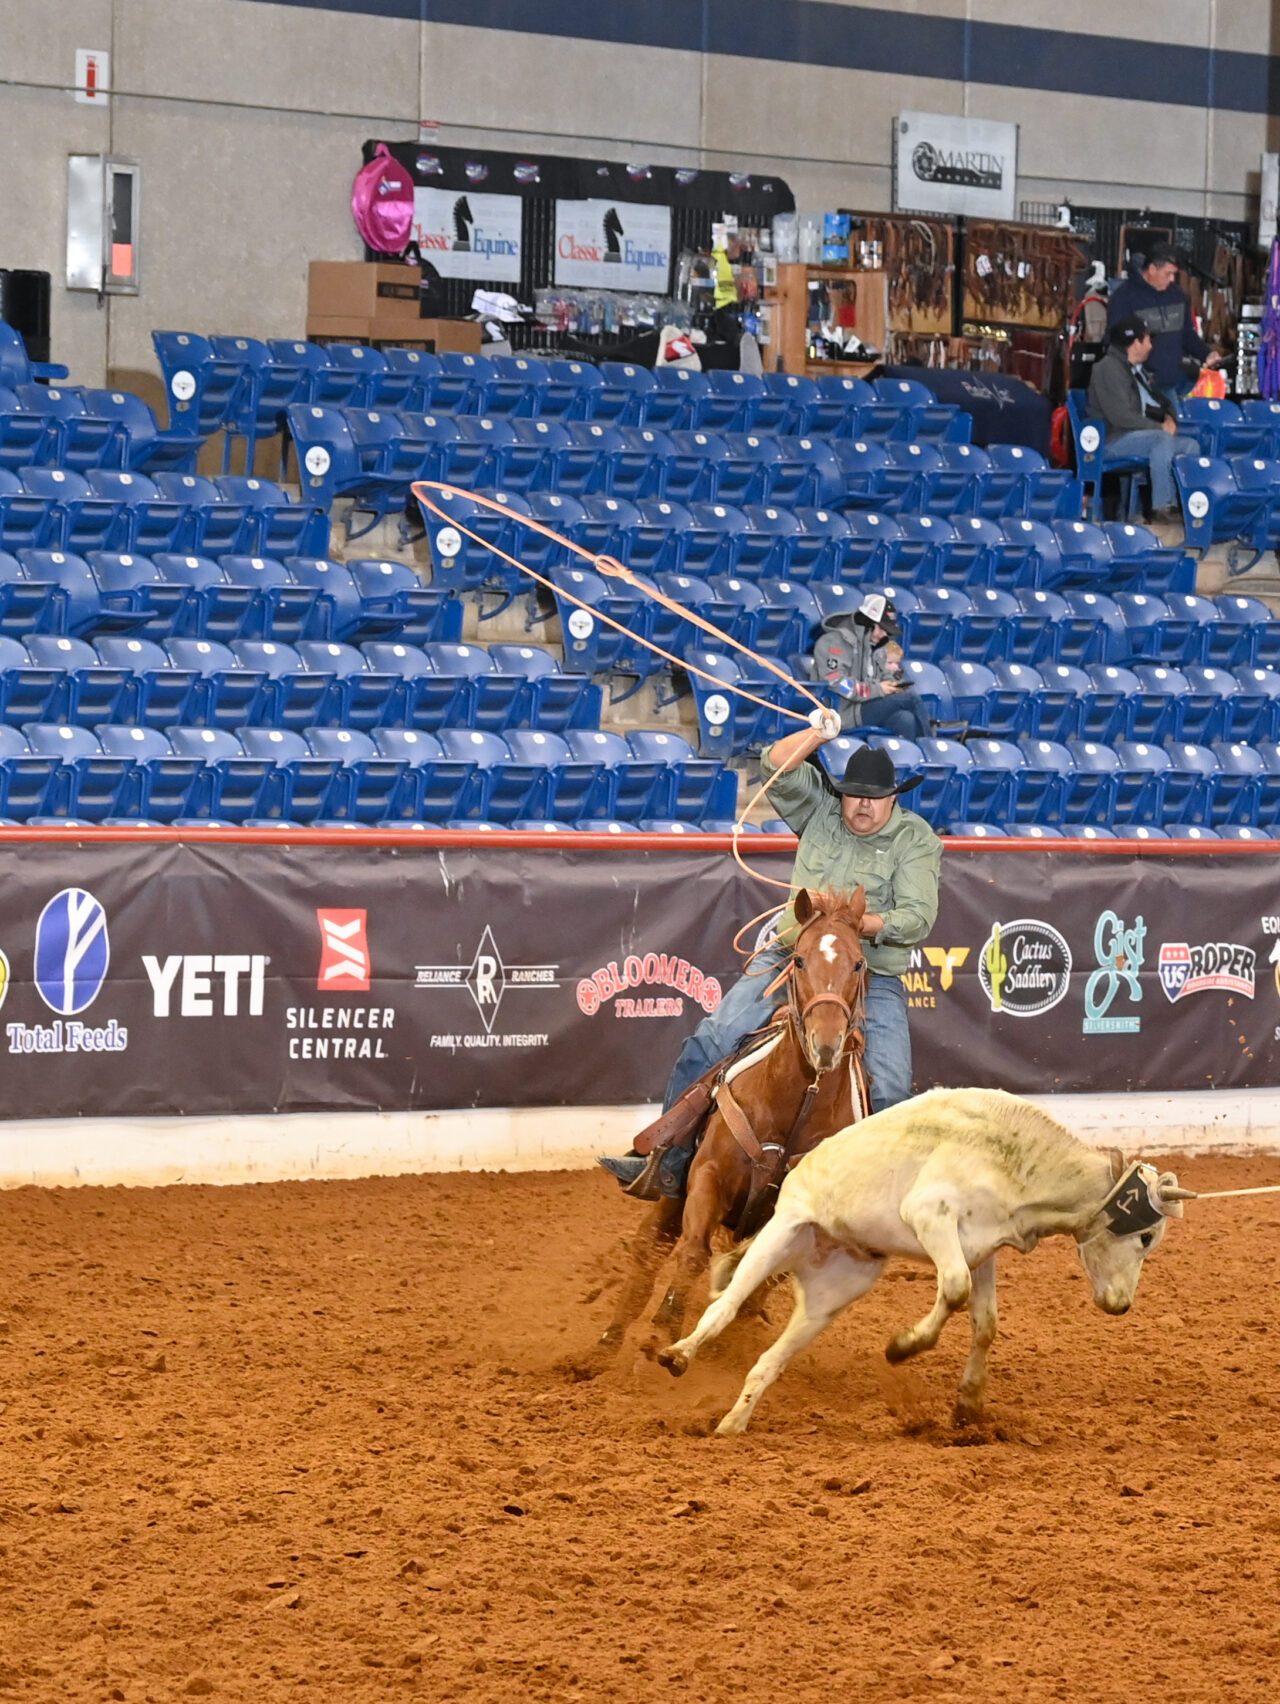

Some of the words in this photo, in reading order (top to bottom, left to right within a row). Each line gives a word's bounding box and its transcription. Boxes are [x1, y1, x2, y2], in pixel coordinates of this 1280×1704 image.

[936, 148, 1004, 174] MARTIN
[413, 222, 450, 249] lassic
[473, 228, 519, 260] Equine
[559, 233, 600, 262] Classic
[624, 240, 667, 271] Equine
[1013, 935, 1053, 965] Cactus
[1190, 946, 1255, 981] ROPER
[142, 954, 266, 1017] YETI
[416, 969, 462, 983] RELIANCE
[511, 969, 555, 983] RANCHES
[592, 953, 705, 1002] BLOOMER
[1004, 964, 1057, 995] Saddlery
[1163, 965, 1187, 988] US
[614, 997, 683, 1018] TRAILERS
[908, 996, 936, 1008] ANCE
[286, 1007, 395, 1029] SILENCER
[6, 1020, 64, 1053] Total
[65, 1019, 128, 1052] Feeds
[289, 1036, 388, 1059] CENTRAL
